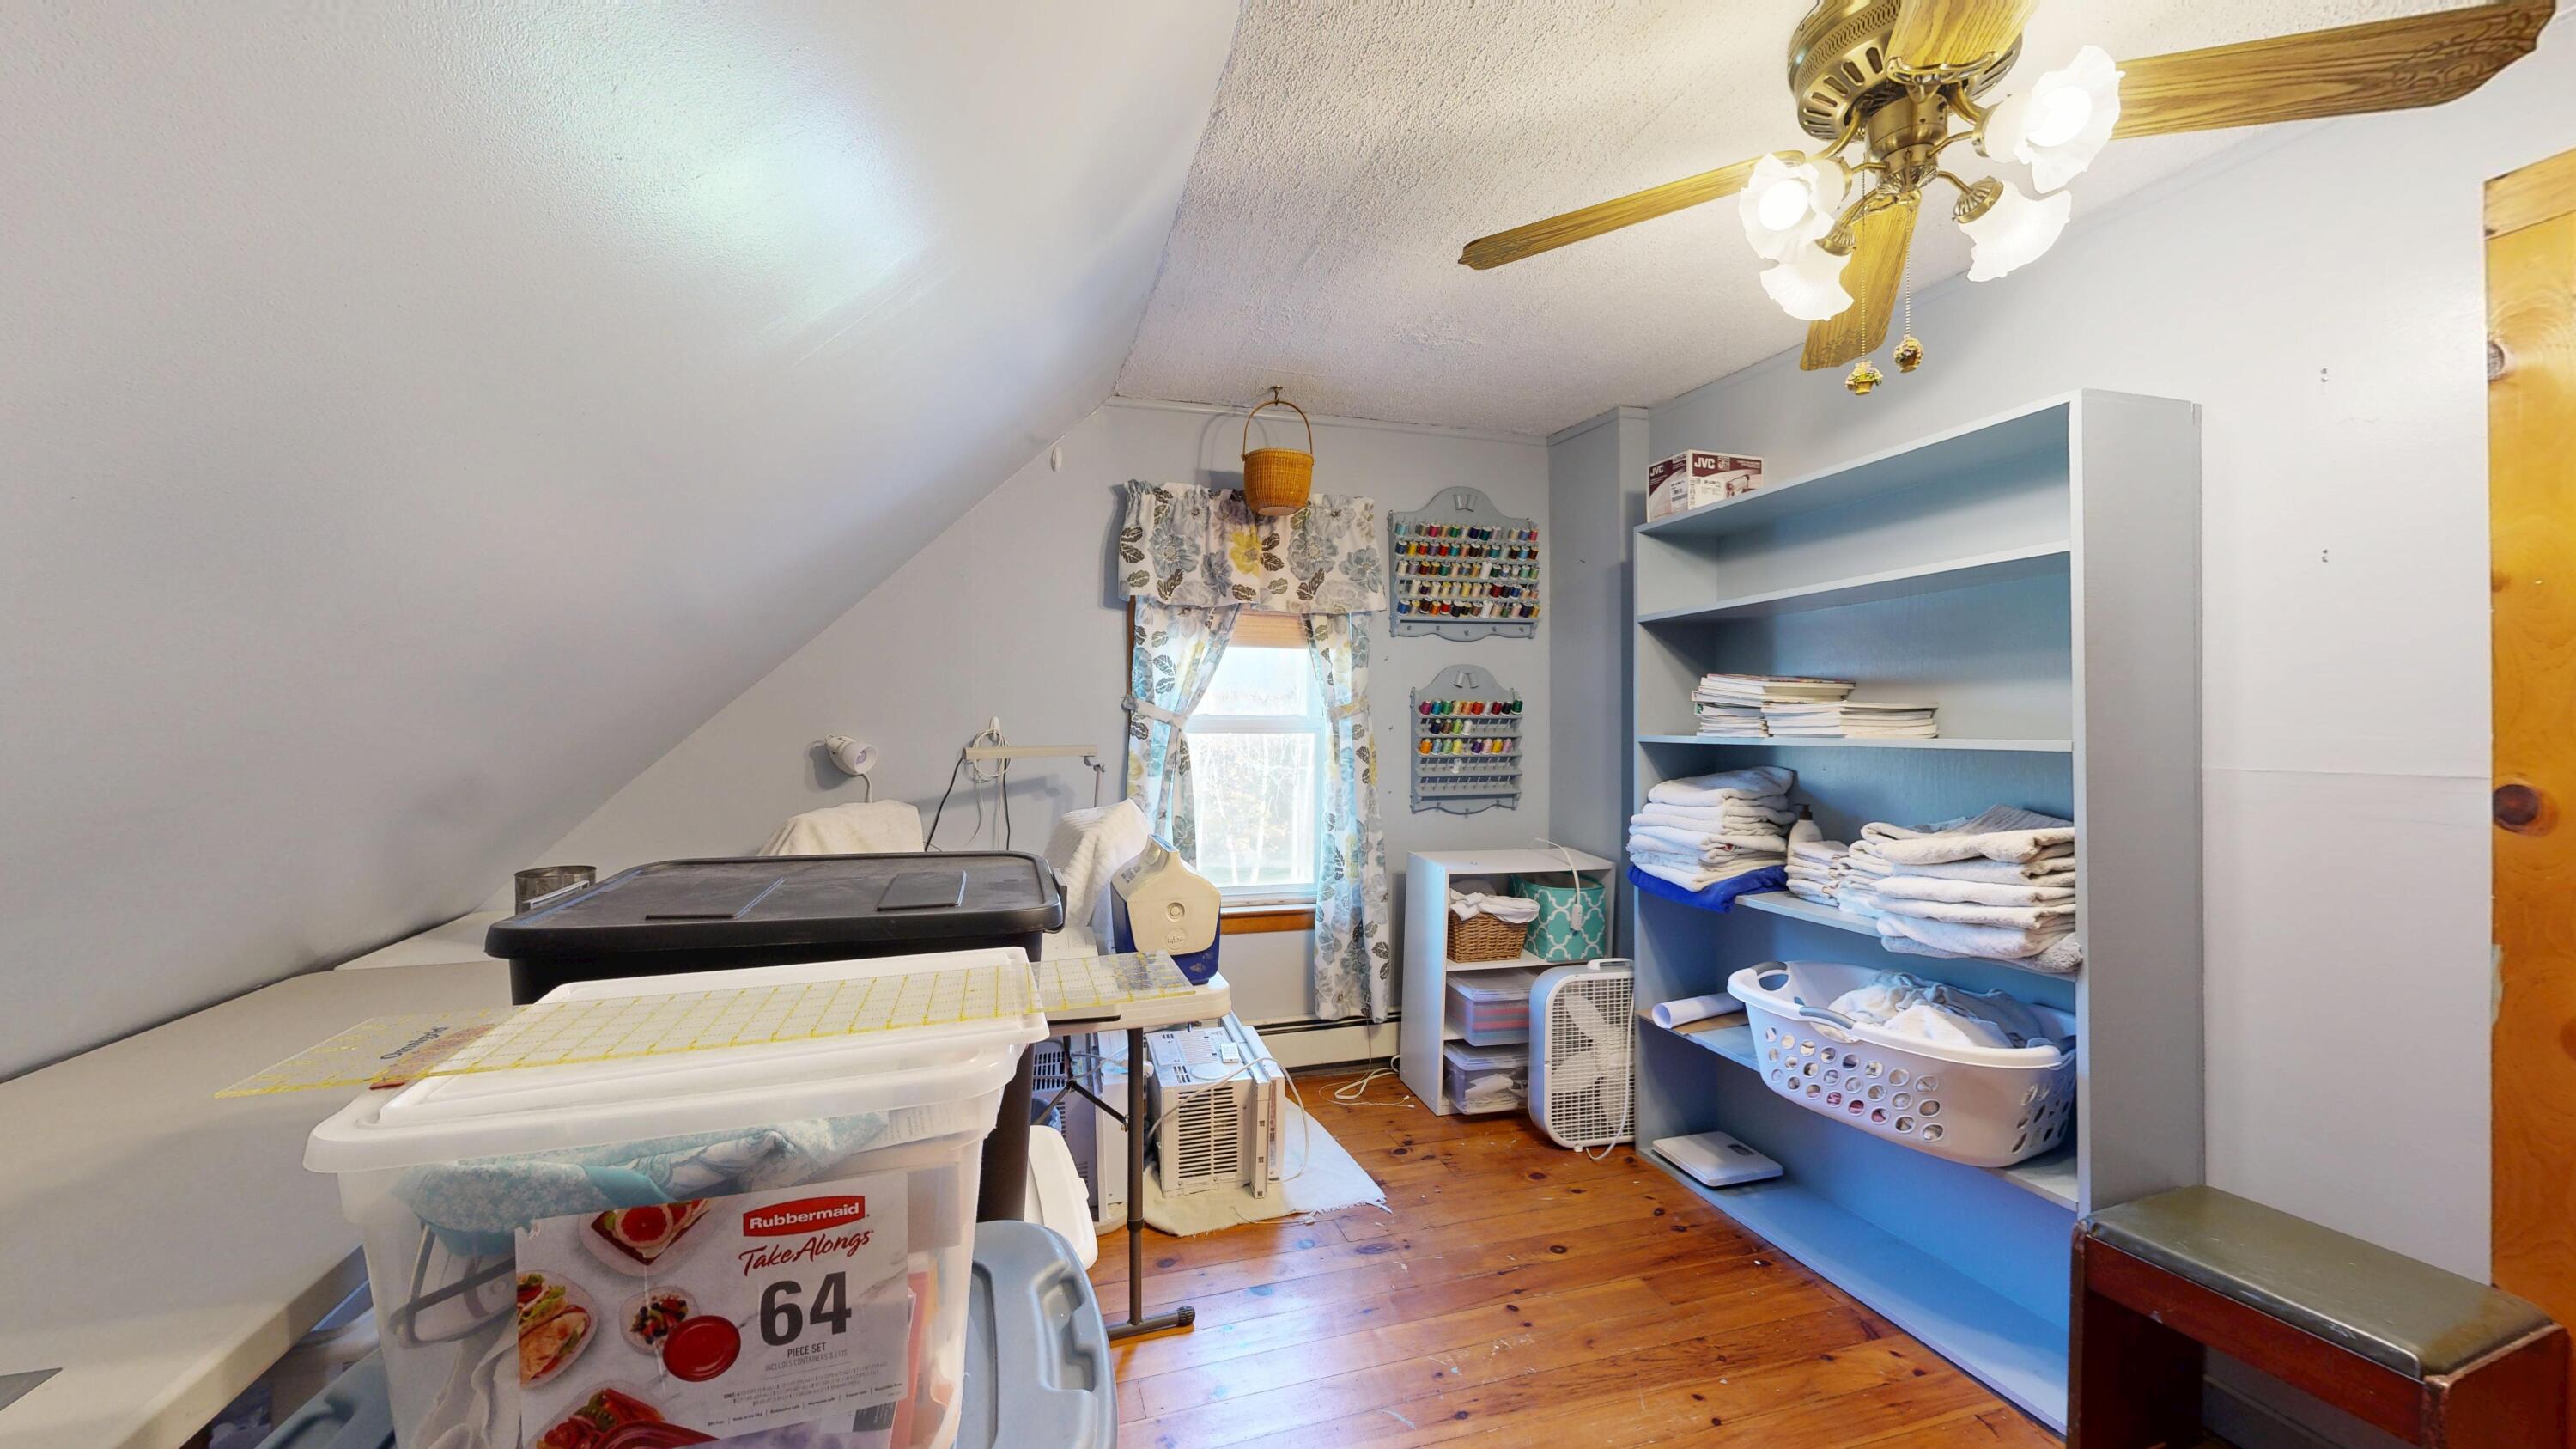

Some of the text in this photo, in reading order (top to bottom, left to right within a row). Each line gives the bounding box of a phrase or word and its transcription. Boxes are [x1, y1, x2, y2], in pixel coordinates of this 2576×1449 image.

[1650, 465, 1664, 477] JVC
[1694, 457, 1716, 469] JVC
[750, 1202, 860, 1230] Rubbermaid
[760, 1270, 852, 1347] 64
[787, 1342, 827, 1358] PIECE SET
[765, 1359, 793, 1372] INCLUDES
[793, 1354, 829, 1368] CONTAINERS
[835, 1349, 848, 1359] LIDS
